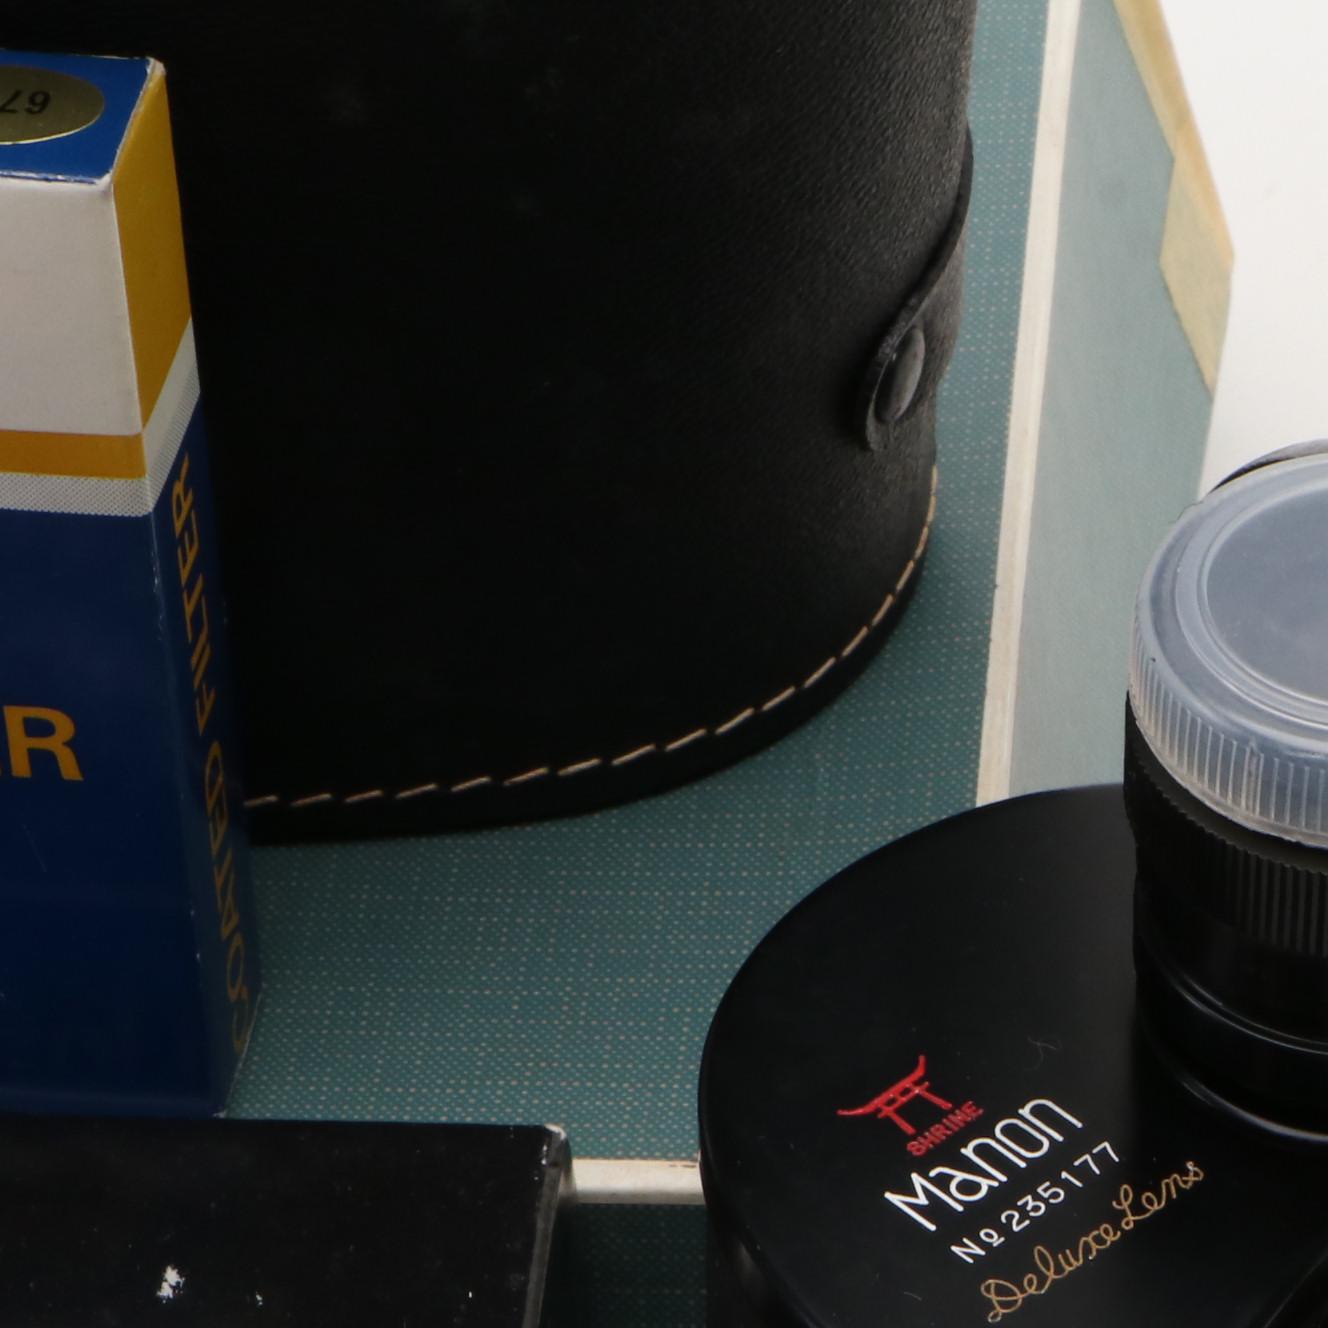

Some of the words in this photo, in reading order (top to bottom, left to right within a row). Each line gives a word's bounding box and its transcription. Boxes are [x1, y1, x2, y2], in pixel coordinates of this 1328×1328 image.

[172, 452, 216, 737] FILTER
[884, 1098, 1084, 1232] Manon
[906, 1100, 985, 1157] SHRINE
[1000, 1140, 1120, 1232] 235177
[980, 1222, 1122, 1323] Deluxe
[1112, 1160, 1205, 1230] Lens
